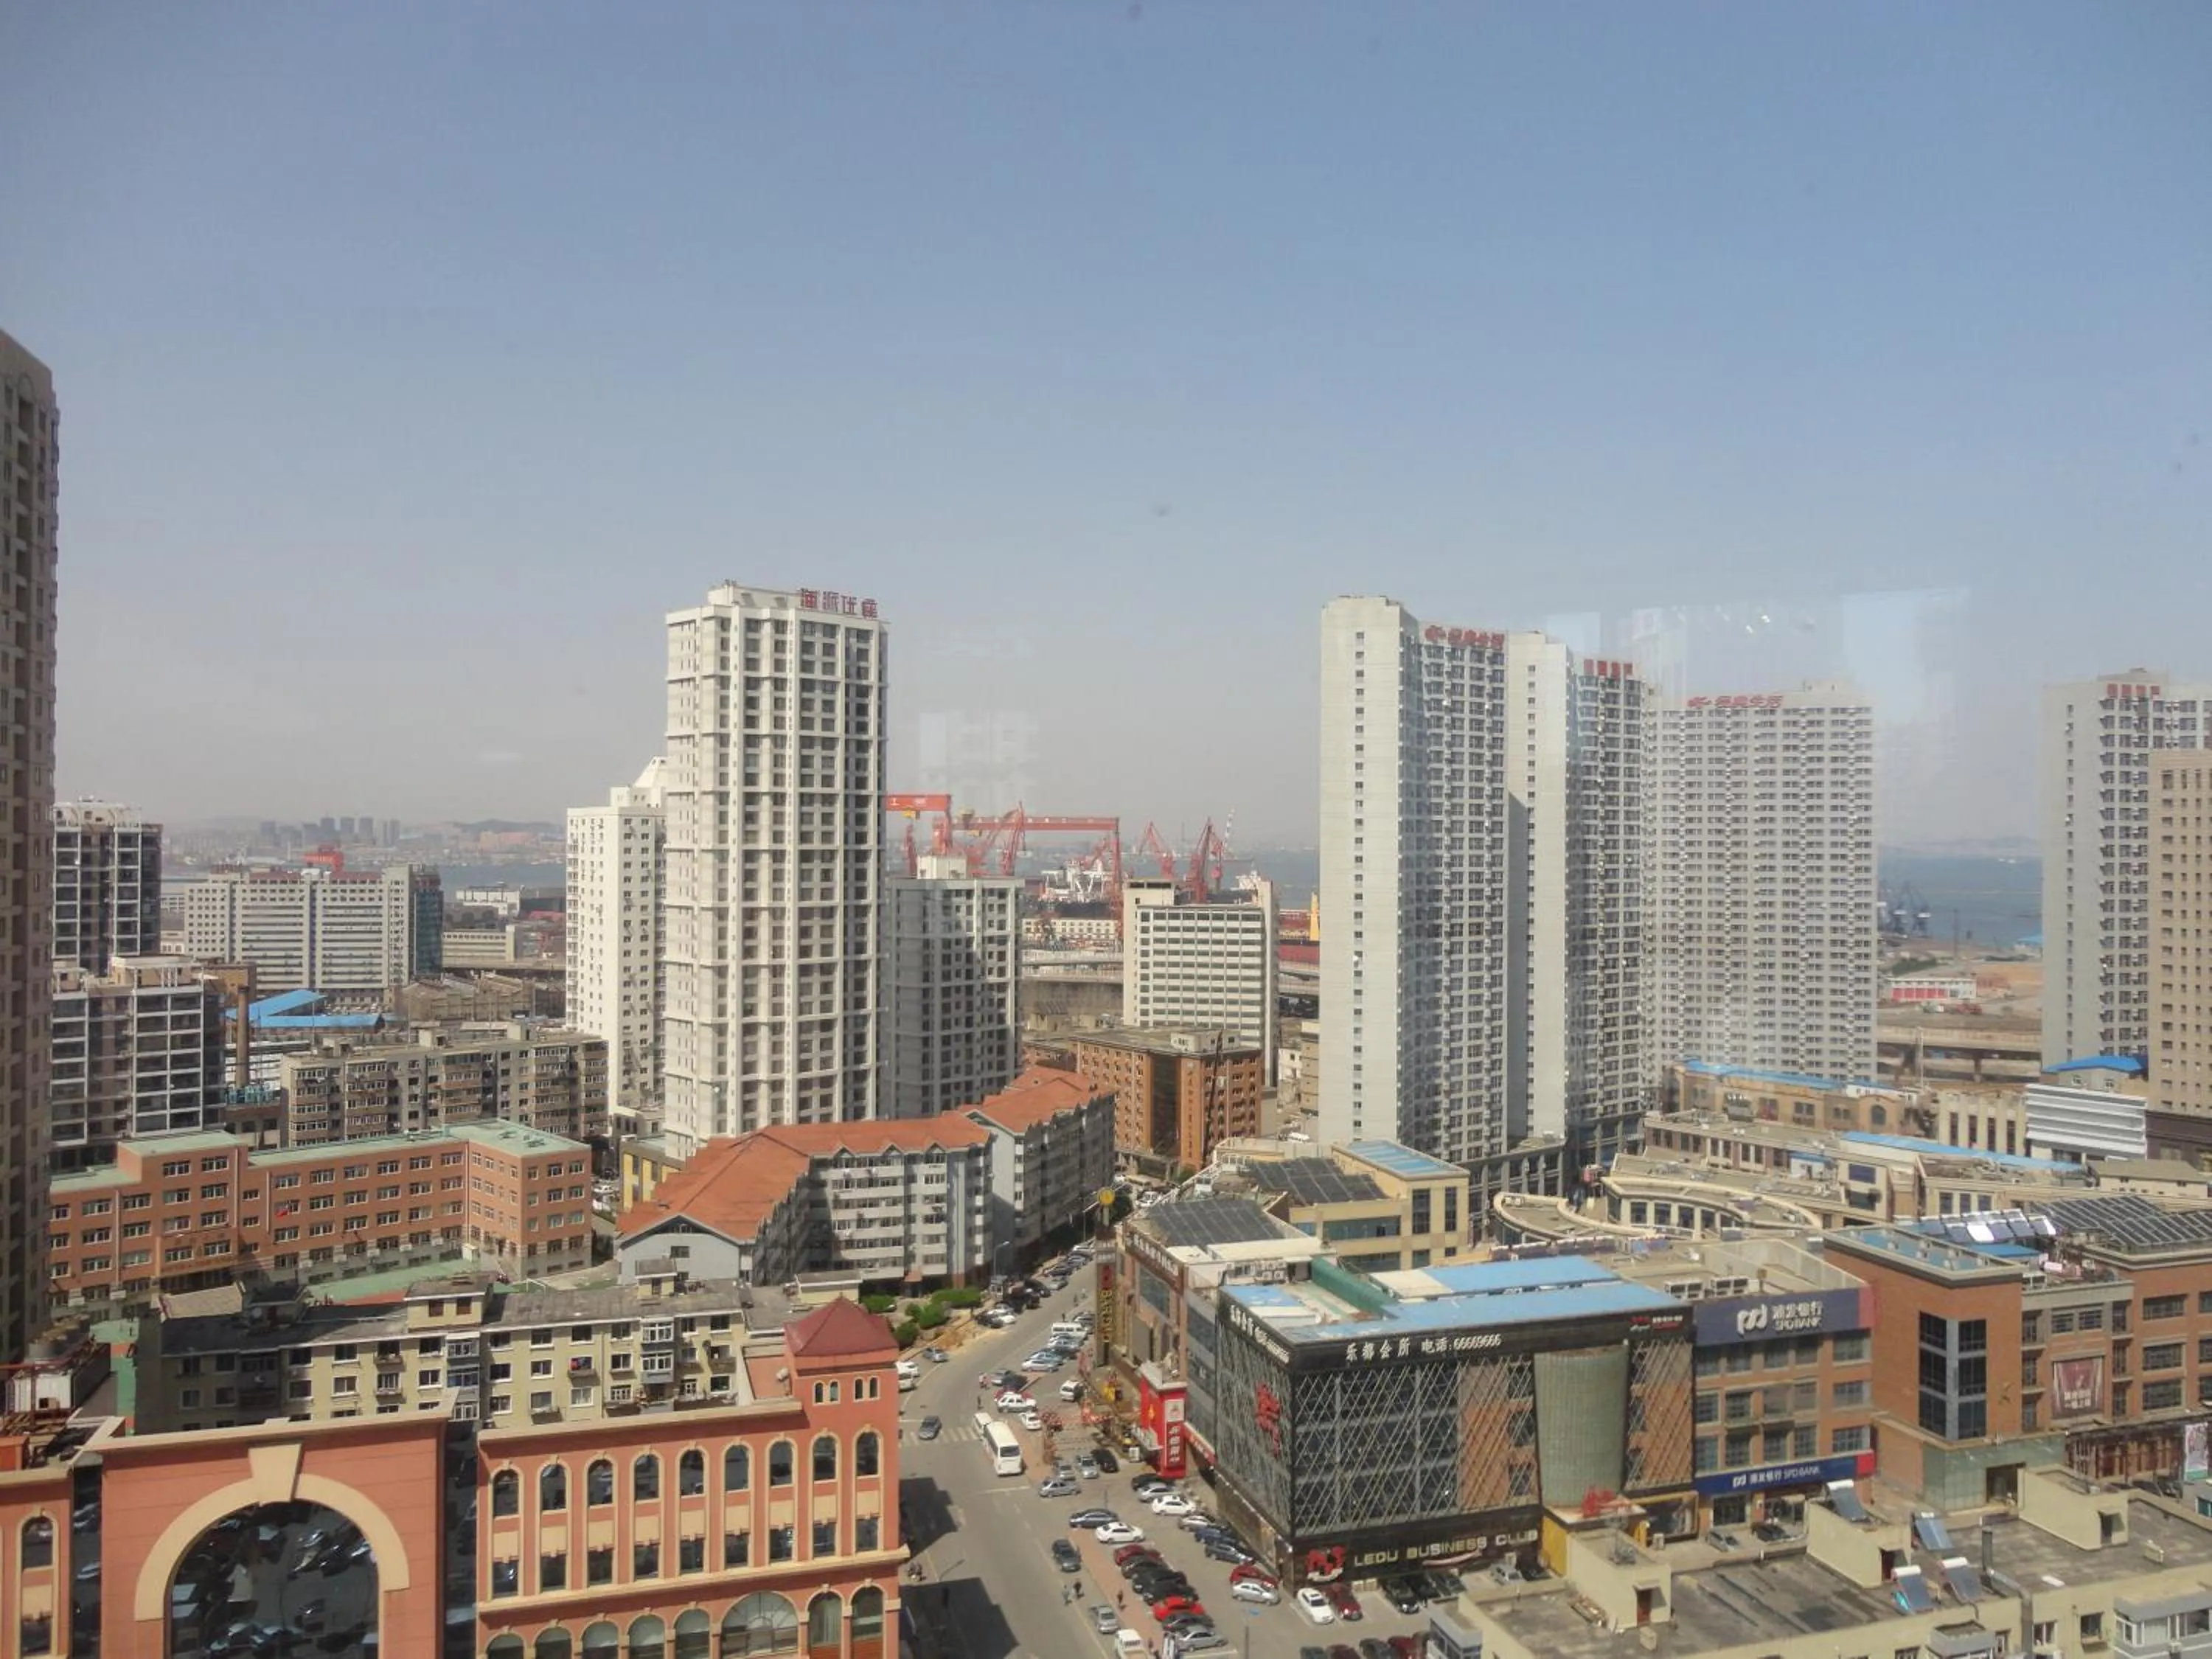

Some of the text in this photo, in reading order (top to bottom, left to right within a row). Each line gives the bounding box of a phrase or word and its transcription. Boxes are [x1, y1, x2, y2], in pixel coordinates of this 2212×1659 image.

[1346, 1336, 1411, 1363] 乐都会所
[1354, 1550, 1399, 1567] LEDU
[1406, 1536, 1487, 1559] BUSINESS
[1495, 1529, 1538, 1546] CLUB
